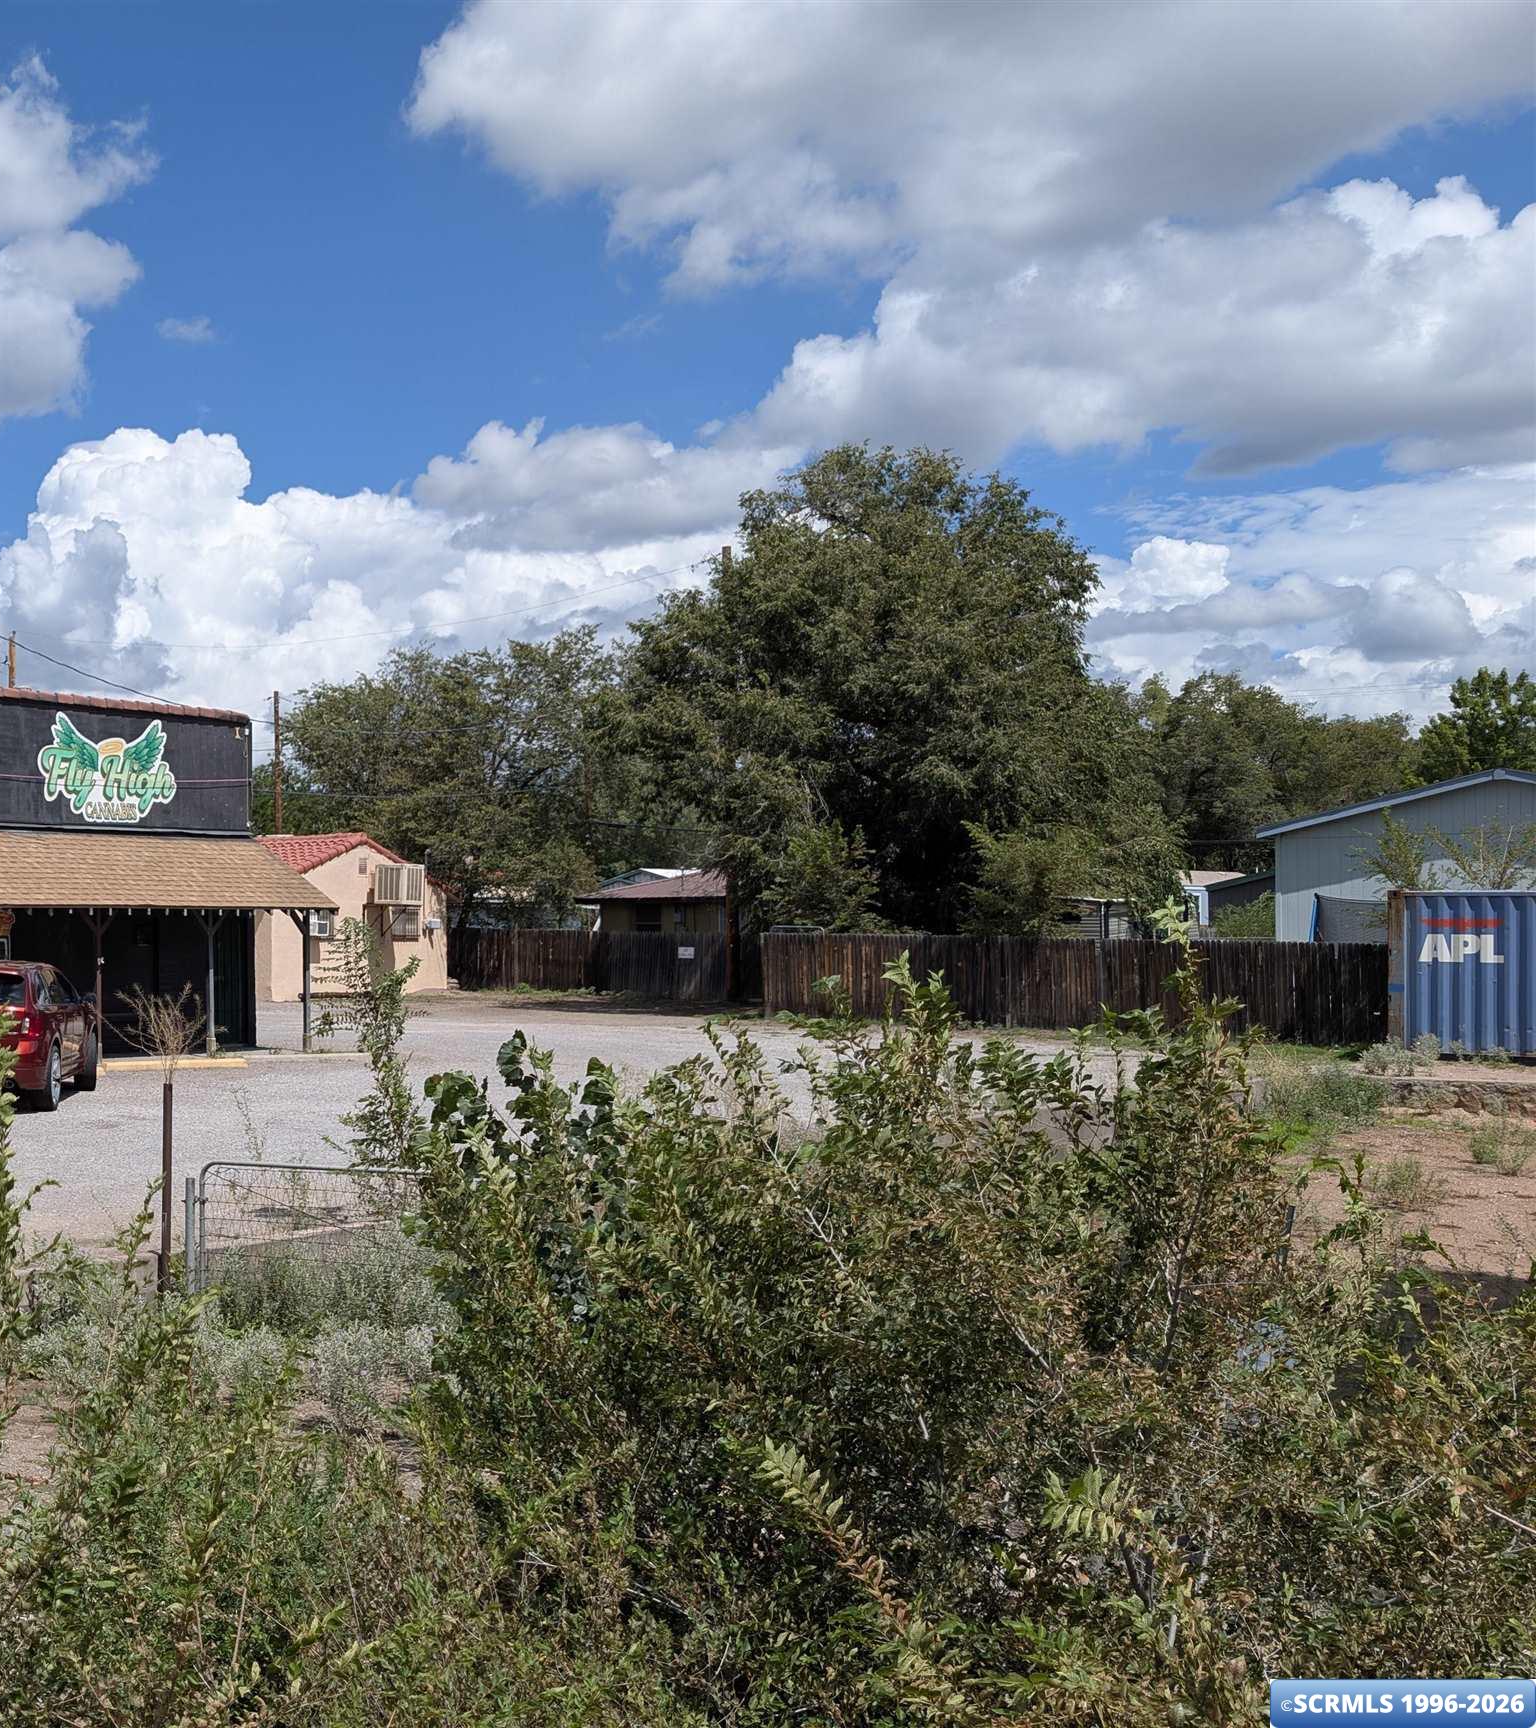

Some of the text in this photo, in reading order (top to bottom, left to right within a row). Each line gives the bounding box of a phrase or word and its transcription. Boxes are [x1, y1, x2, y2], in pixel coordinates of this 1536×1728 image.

[41, 747, 174, 813] Fly High
[85, 802, 138, 820] CANNABIS
[1418, 934, 1504, 963] APL
